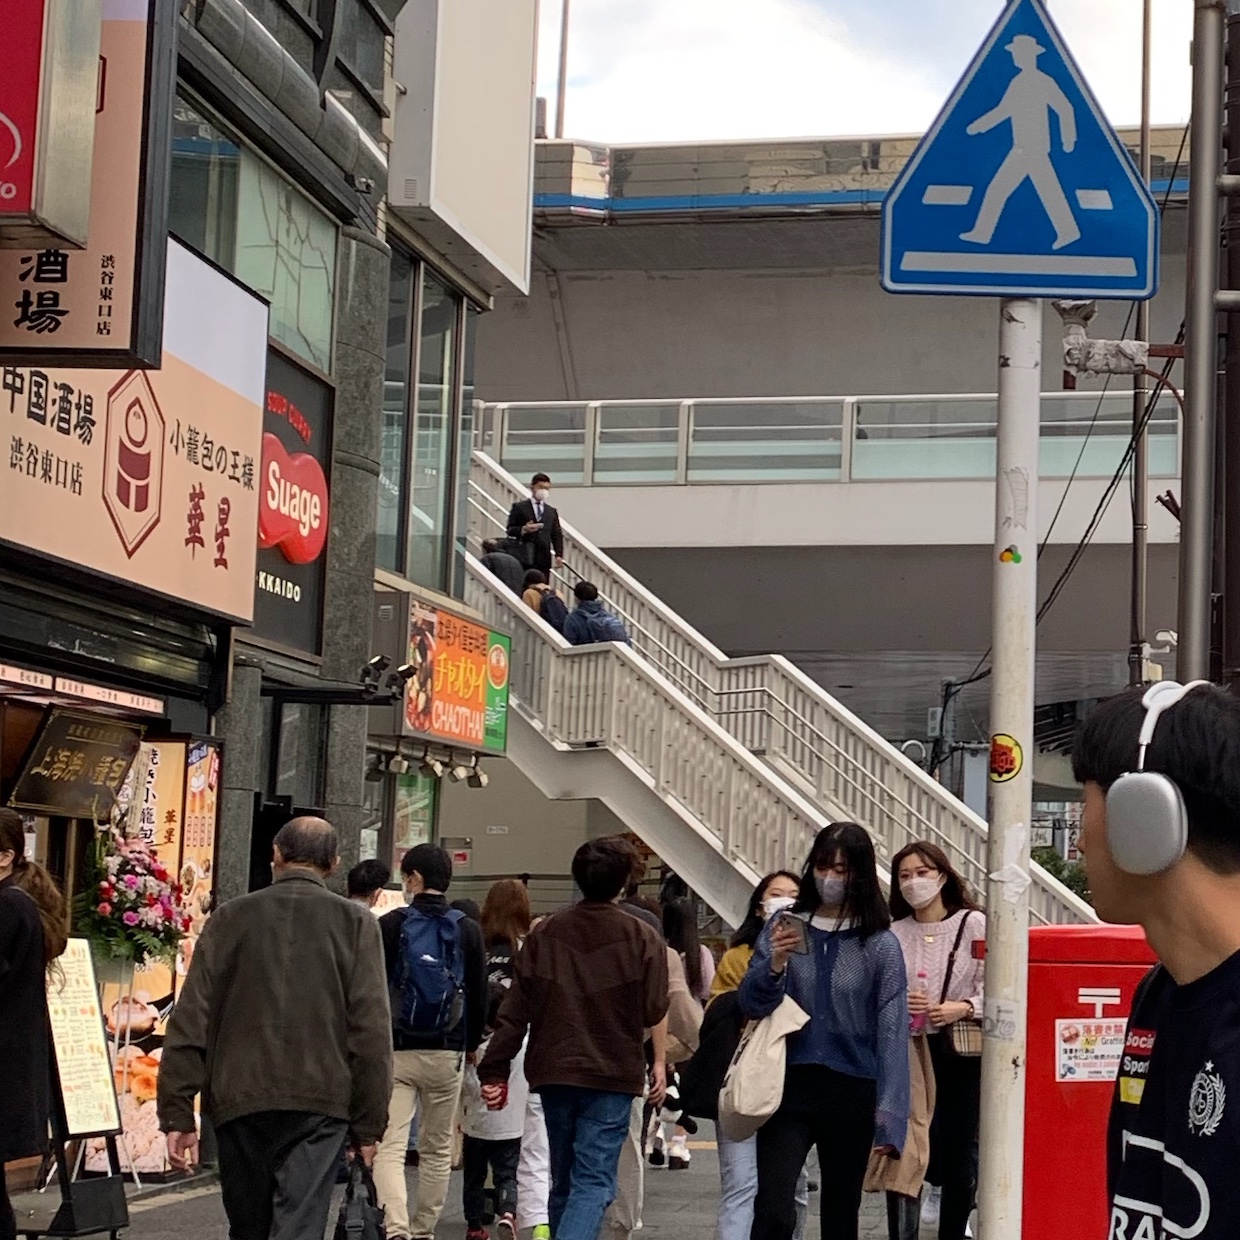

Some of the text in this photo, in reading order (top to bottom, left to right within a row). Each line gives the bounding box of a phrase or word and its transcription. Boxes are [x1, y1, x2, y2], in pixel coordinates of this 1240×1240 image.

[14, 249, 70, 334] 酒場
[96, 254, 116, 336] 渋谷東口店
[2, 366, 97, 446] 中国酒場
[9, 435, 84, 497] 渋谷東口店
[169, 418, 255, 491] 小籠包の王様
[266, 460, 322, 538] Suage
[257, 570, 301, 603] KKAIDO
[431, 700, 485, 740] CHAOTHAI
